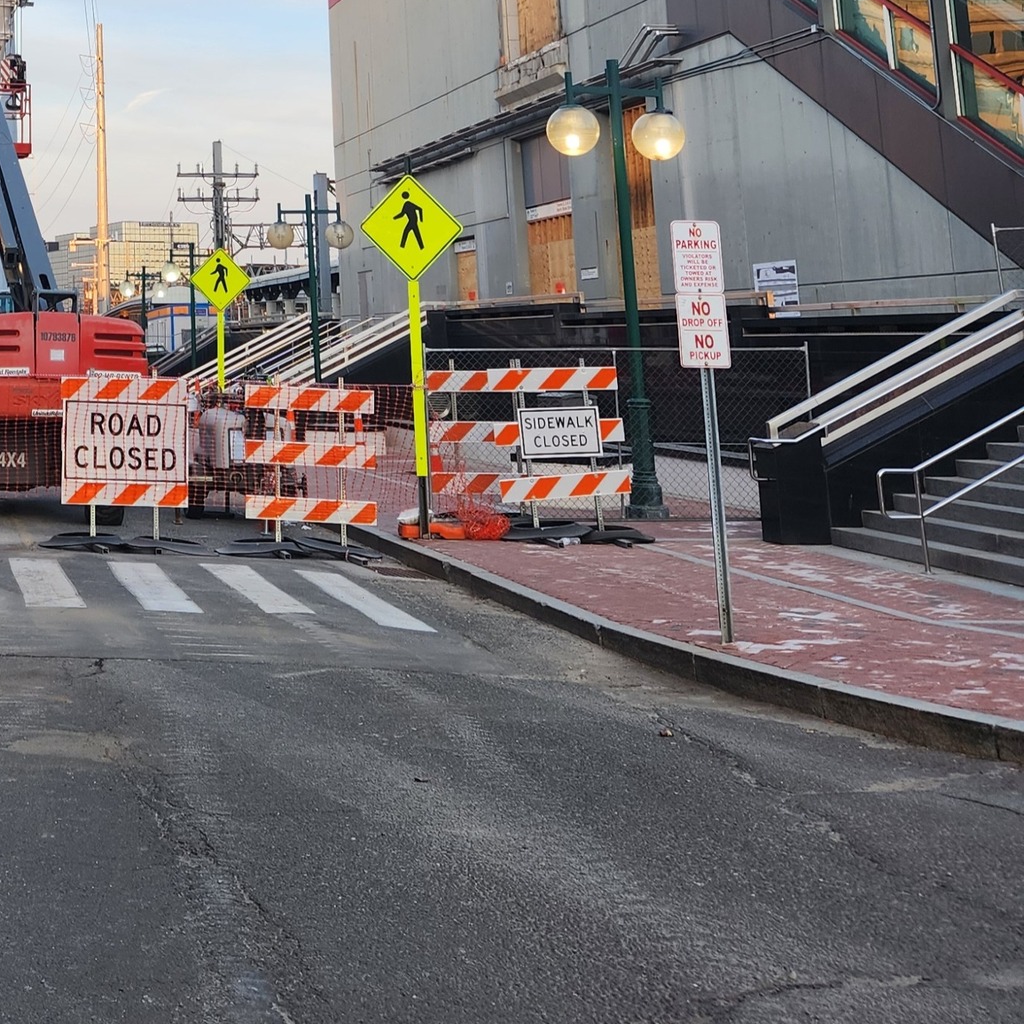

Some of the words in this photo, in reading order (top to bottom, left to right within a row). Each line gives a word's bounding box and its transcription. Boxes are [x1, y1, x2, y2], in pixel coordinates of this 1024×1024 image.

[689, 228, 702, 237] NO
[676, 240, 717, 249] PARKING
[691, 301, 710, 316] NO
[682, 318, 704, 327] DROP
[707, 318, 723, 327] OFF
[695, 334, 714, 349] NO
[689, 351, 722, 360] PICKUP
[90, 412, 162, 437] ROAD
[524, 416, 593, 430] SIDEWALK
[533, 434, 588, 448] CLOSED
[74, 445, 177, 471] CLOSED
